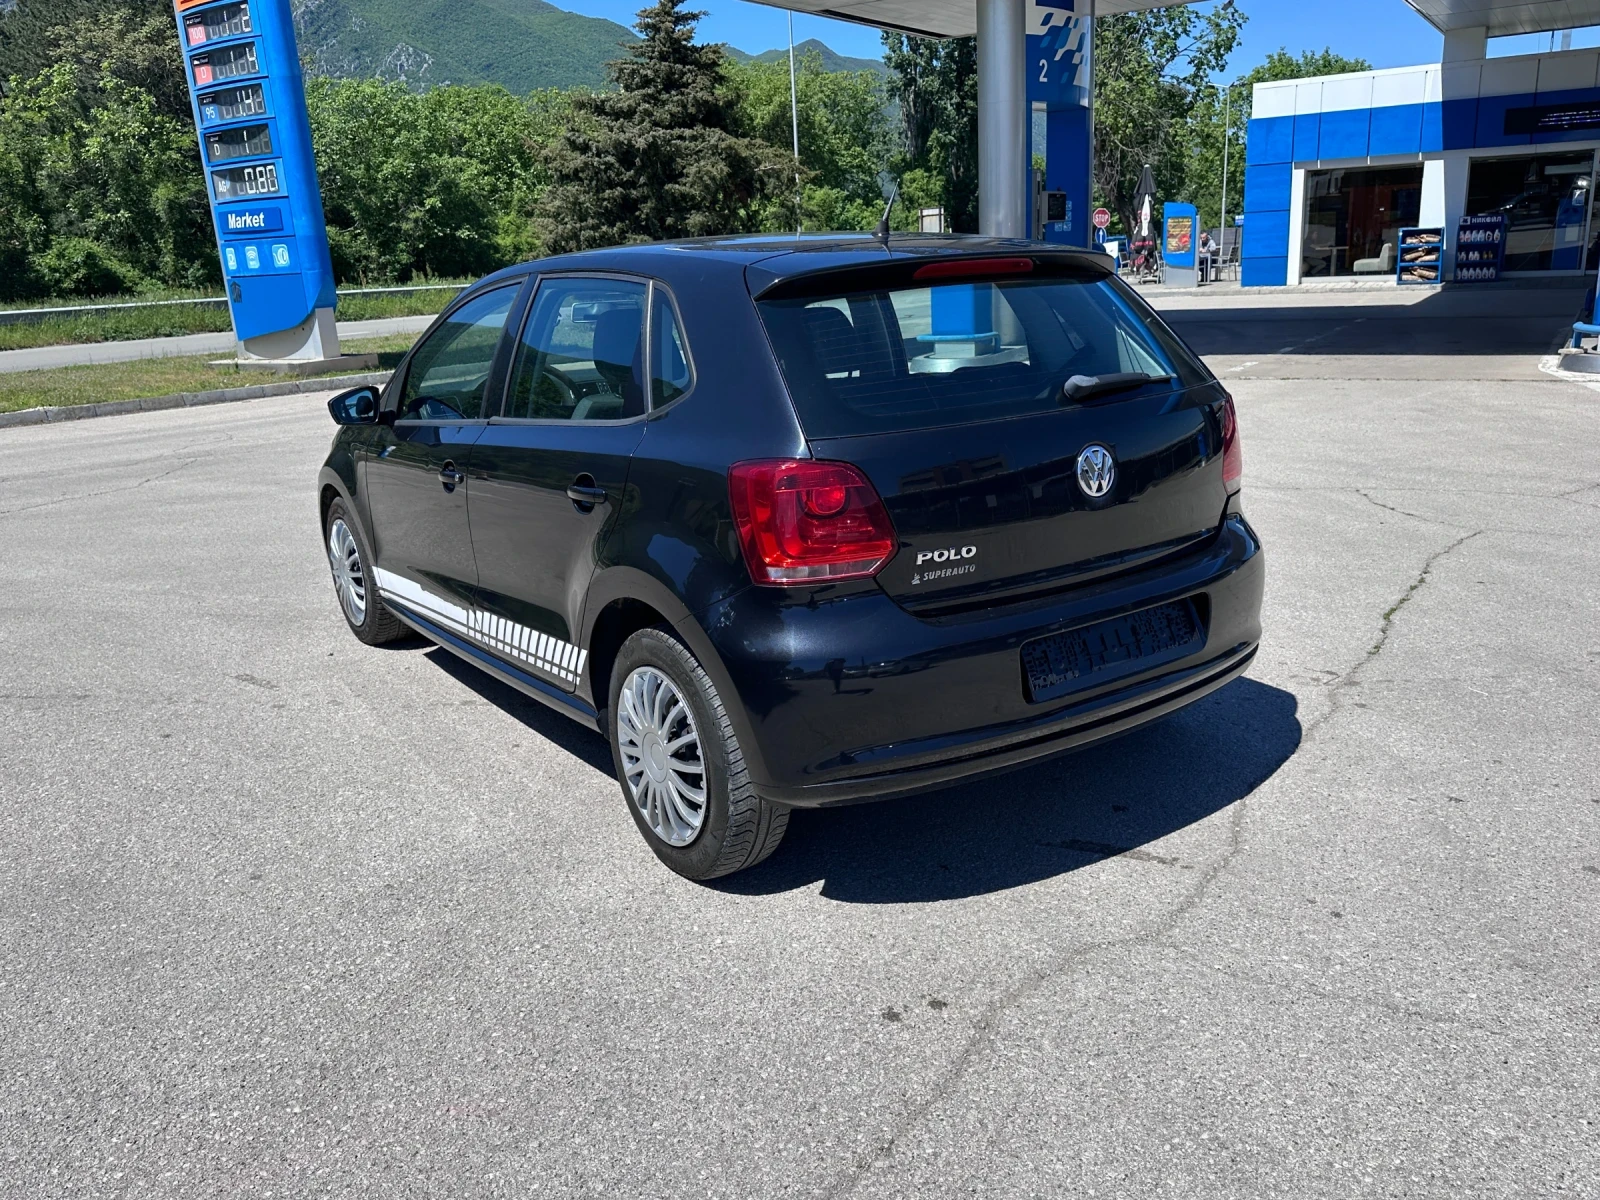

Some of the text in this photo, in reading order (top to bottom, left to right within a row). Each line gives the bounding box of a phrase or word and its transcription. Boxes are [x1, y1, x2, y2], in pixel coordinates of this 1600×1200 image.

[191, 26, 203, 40] 100
[200, 66, 207, 79] D
[1039, 59, 1048, 82] 2
[205, 106, 216, 119] 95
[213, 143, 221, 156] D
[243, 165, 279, 194] 0.80
[227, 211, 265, 229] Market
[1095, 214, 1109, 222] STOP
[916, 545, 977, 565] POLO
[923, 564, 976, 581] SUPERAUTO
